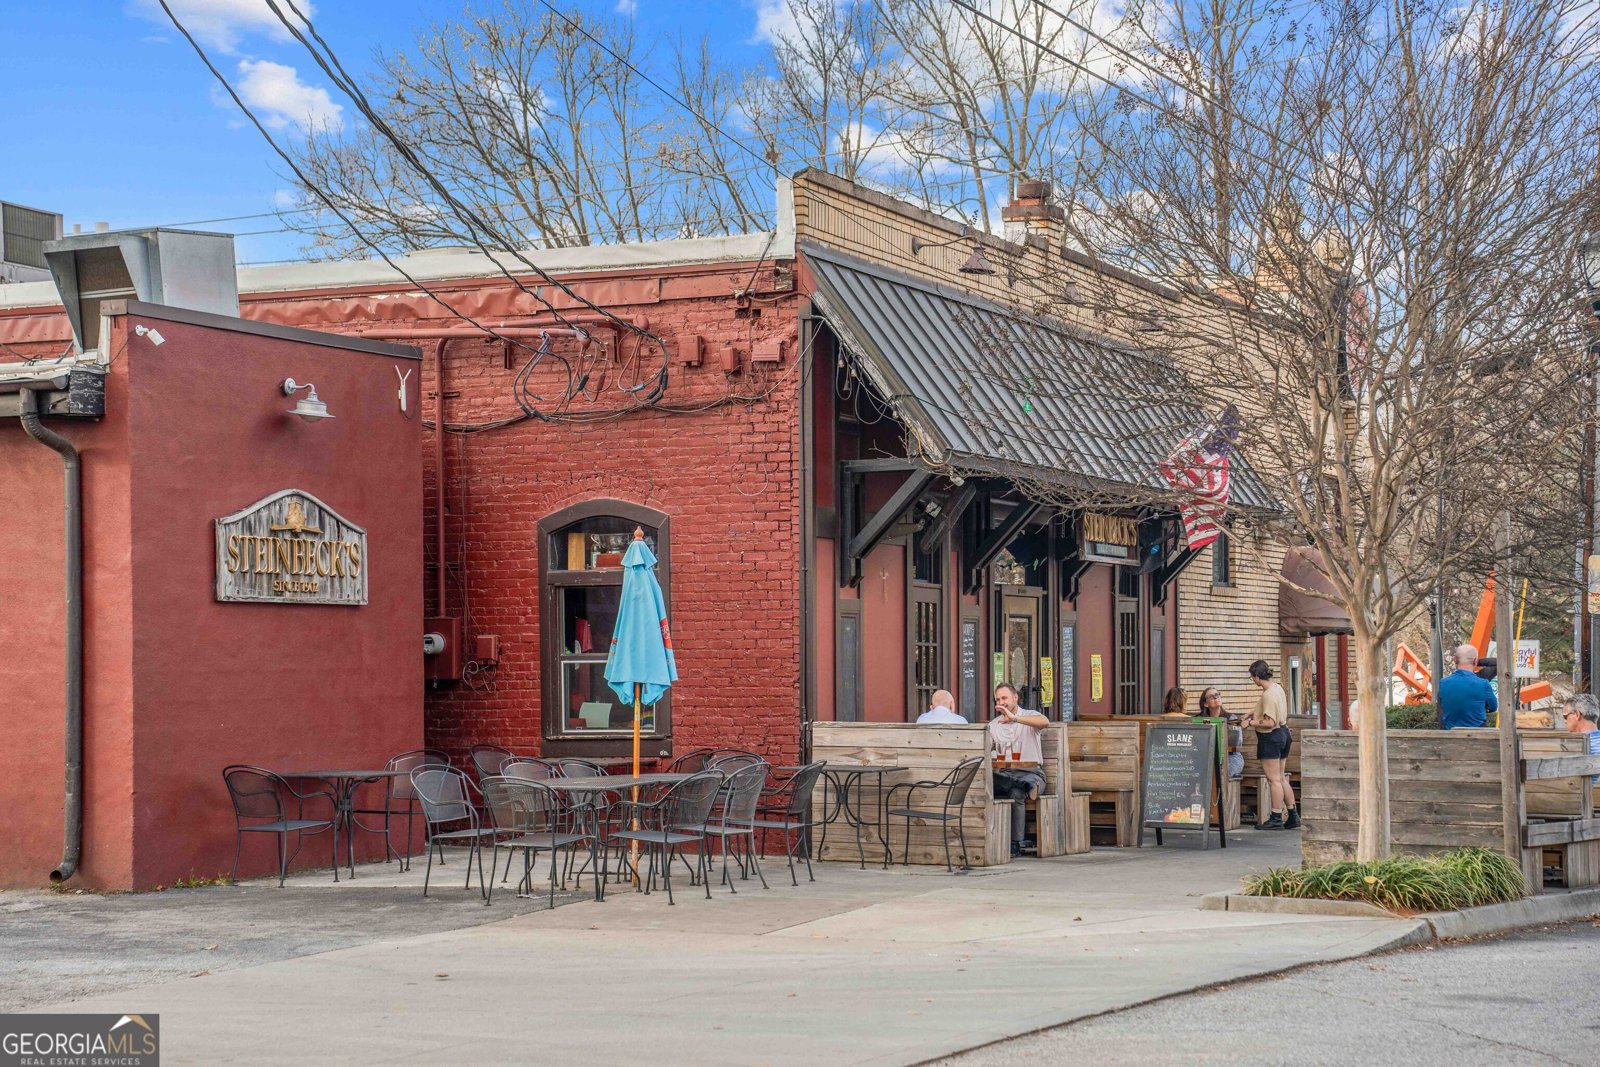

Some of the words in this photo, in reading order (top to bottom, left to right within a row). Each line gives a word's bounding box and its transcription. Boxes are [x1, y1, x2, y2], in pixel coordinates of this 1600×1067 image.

[227, 535, 361, 578] STEINBECK'S
[272, 580, 300, 592] SINCE
[1166, 734, 1194, 743] SLANE
